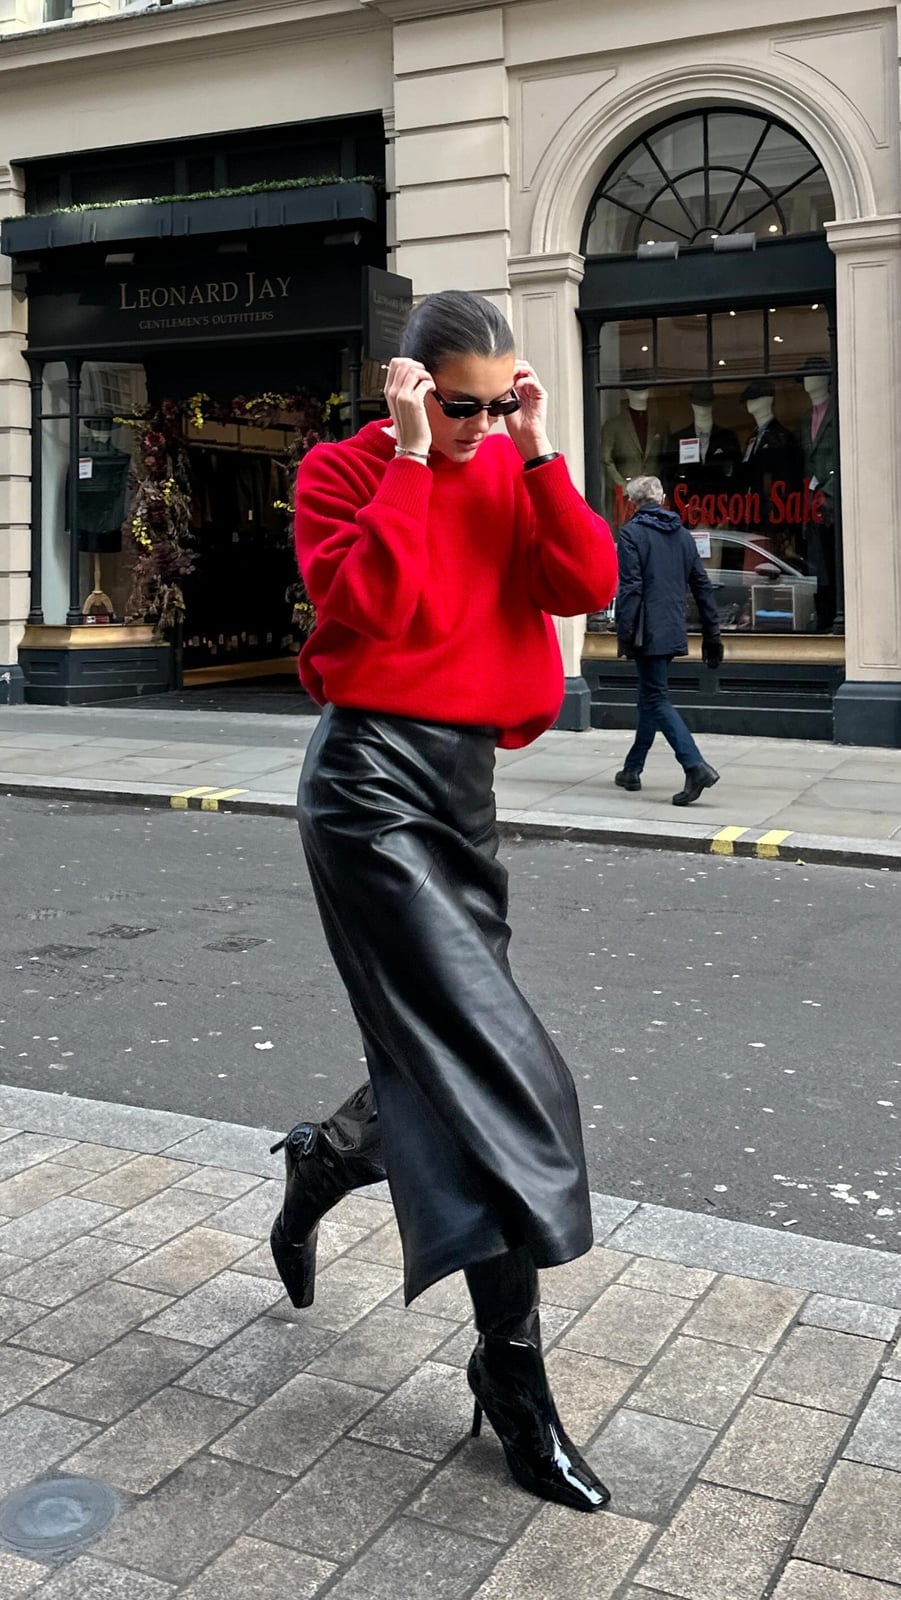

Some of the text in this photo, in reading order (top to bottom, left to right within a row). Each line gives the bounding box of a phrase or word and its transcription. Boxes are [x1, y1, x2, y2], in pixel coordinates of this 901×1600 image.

[119, 271, 292, 310] LEONARD JAY
[139, 311, 274, 330] GENTLEMEN'S OUTFITTERS
[769, 477, 826, 525] Sale
